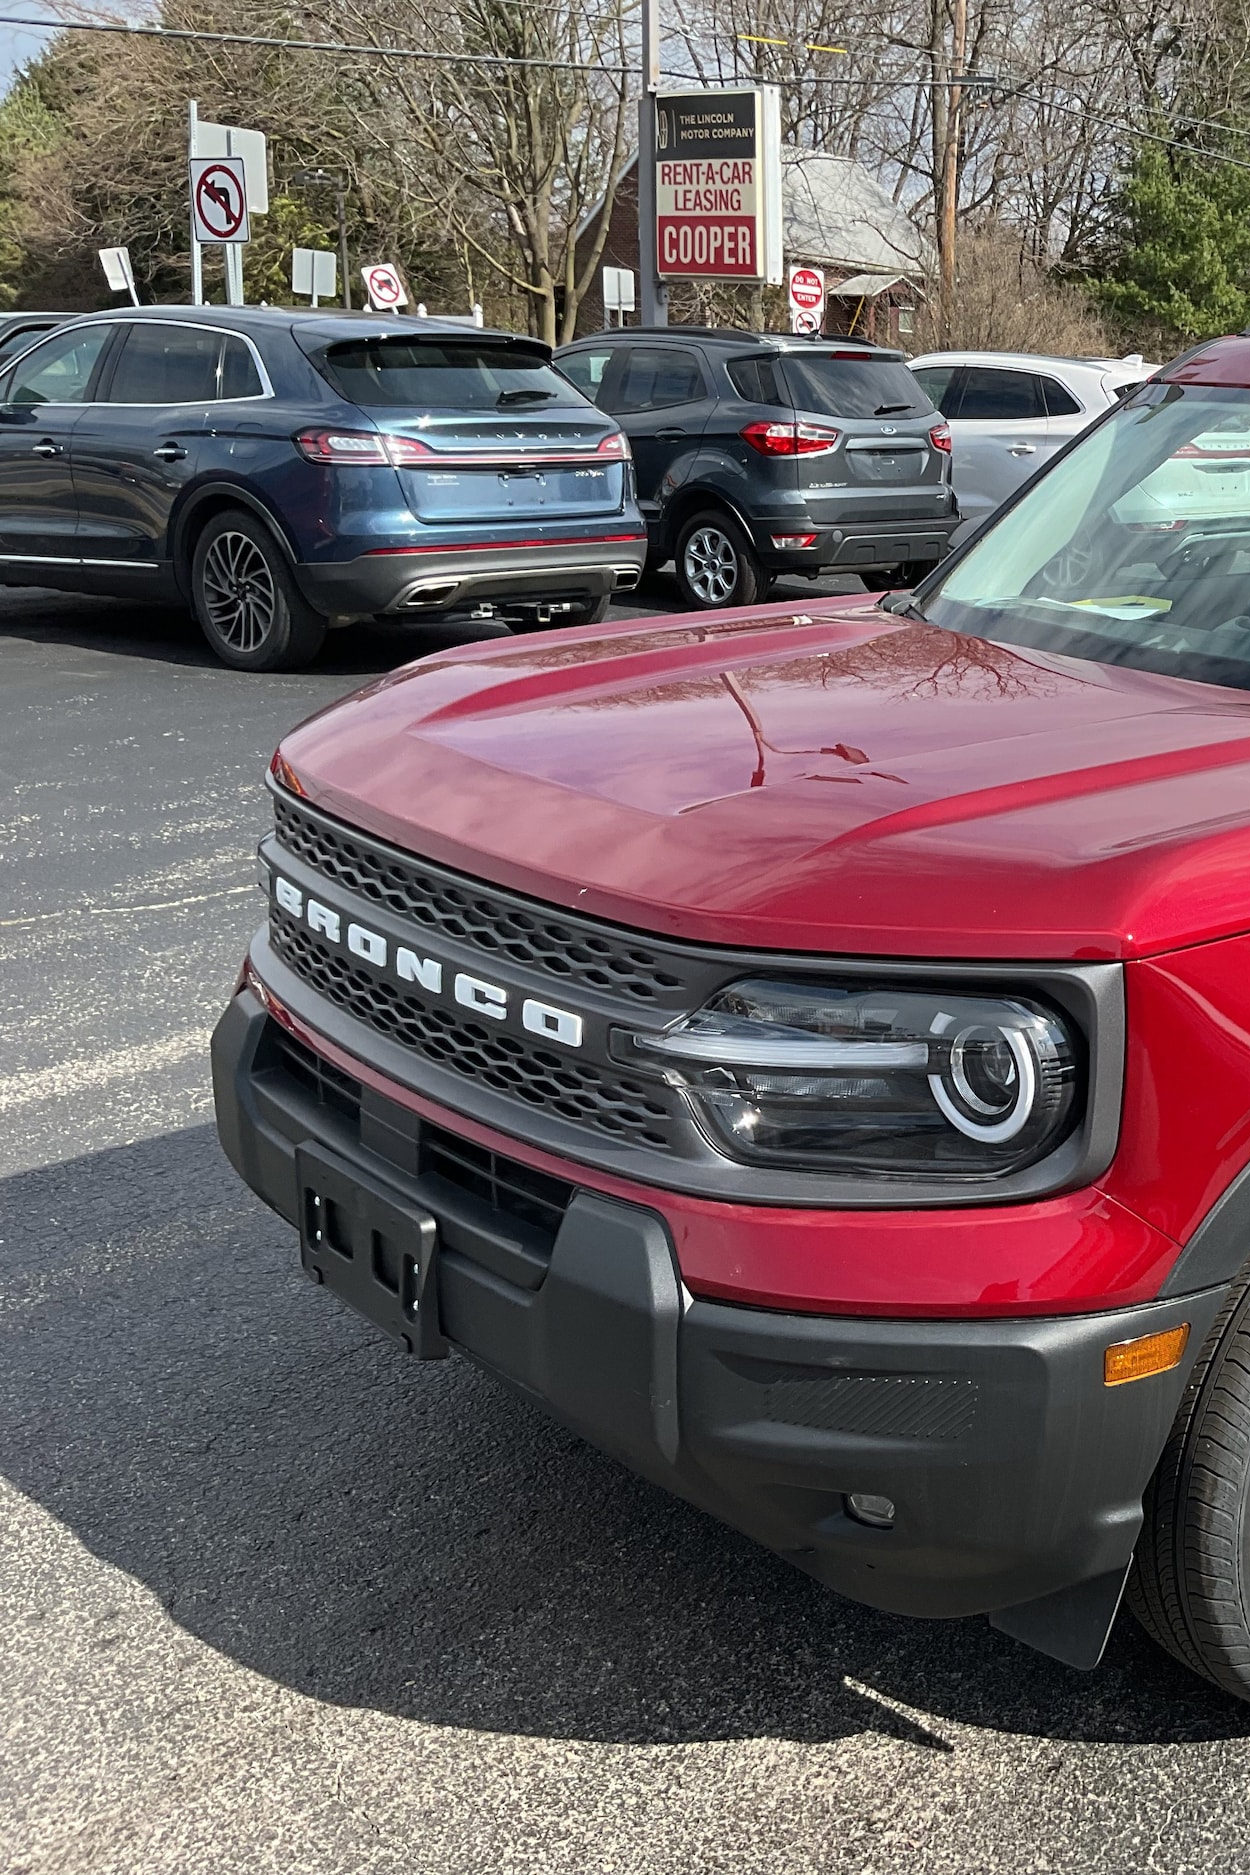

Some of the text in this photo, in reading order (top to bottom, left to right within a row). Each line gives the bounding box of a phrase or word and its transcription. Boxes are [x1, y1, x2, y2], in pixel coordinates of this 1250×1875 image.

[680, 112, 734, 125] THE LINCOLN
[680, 127, 754, 140] MOTOR COMPANY
[661, 161, 753, 186] RENT-A-CAR
[674, 188, 742, 212] LEASING
[663, 225, 751, 266] COOPER
[795, 275, 819, 286] DO NOT
[797, 293, 817, 303] ENTER
[275, 875, 584, 1048] BRONCO
